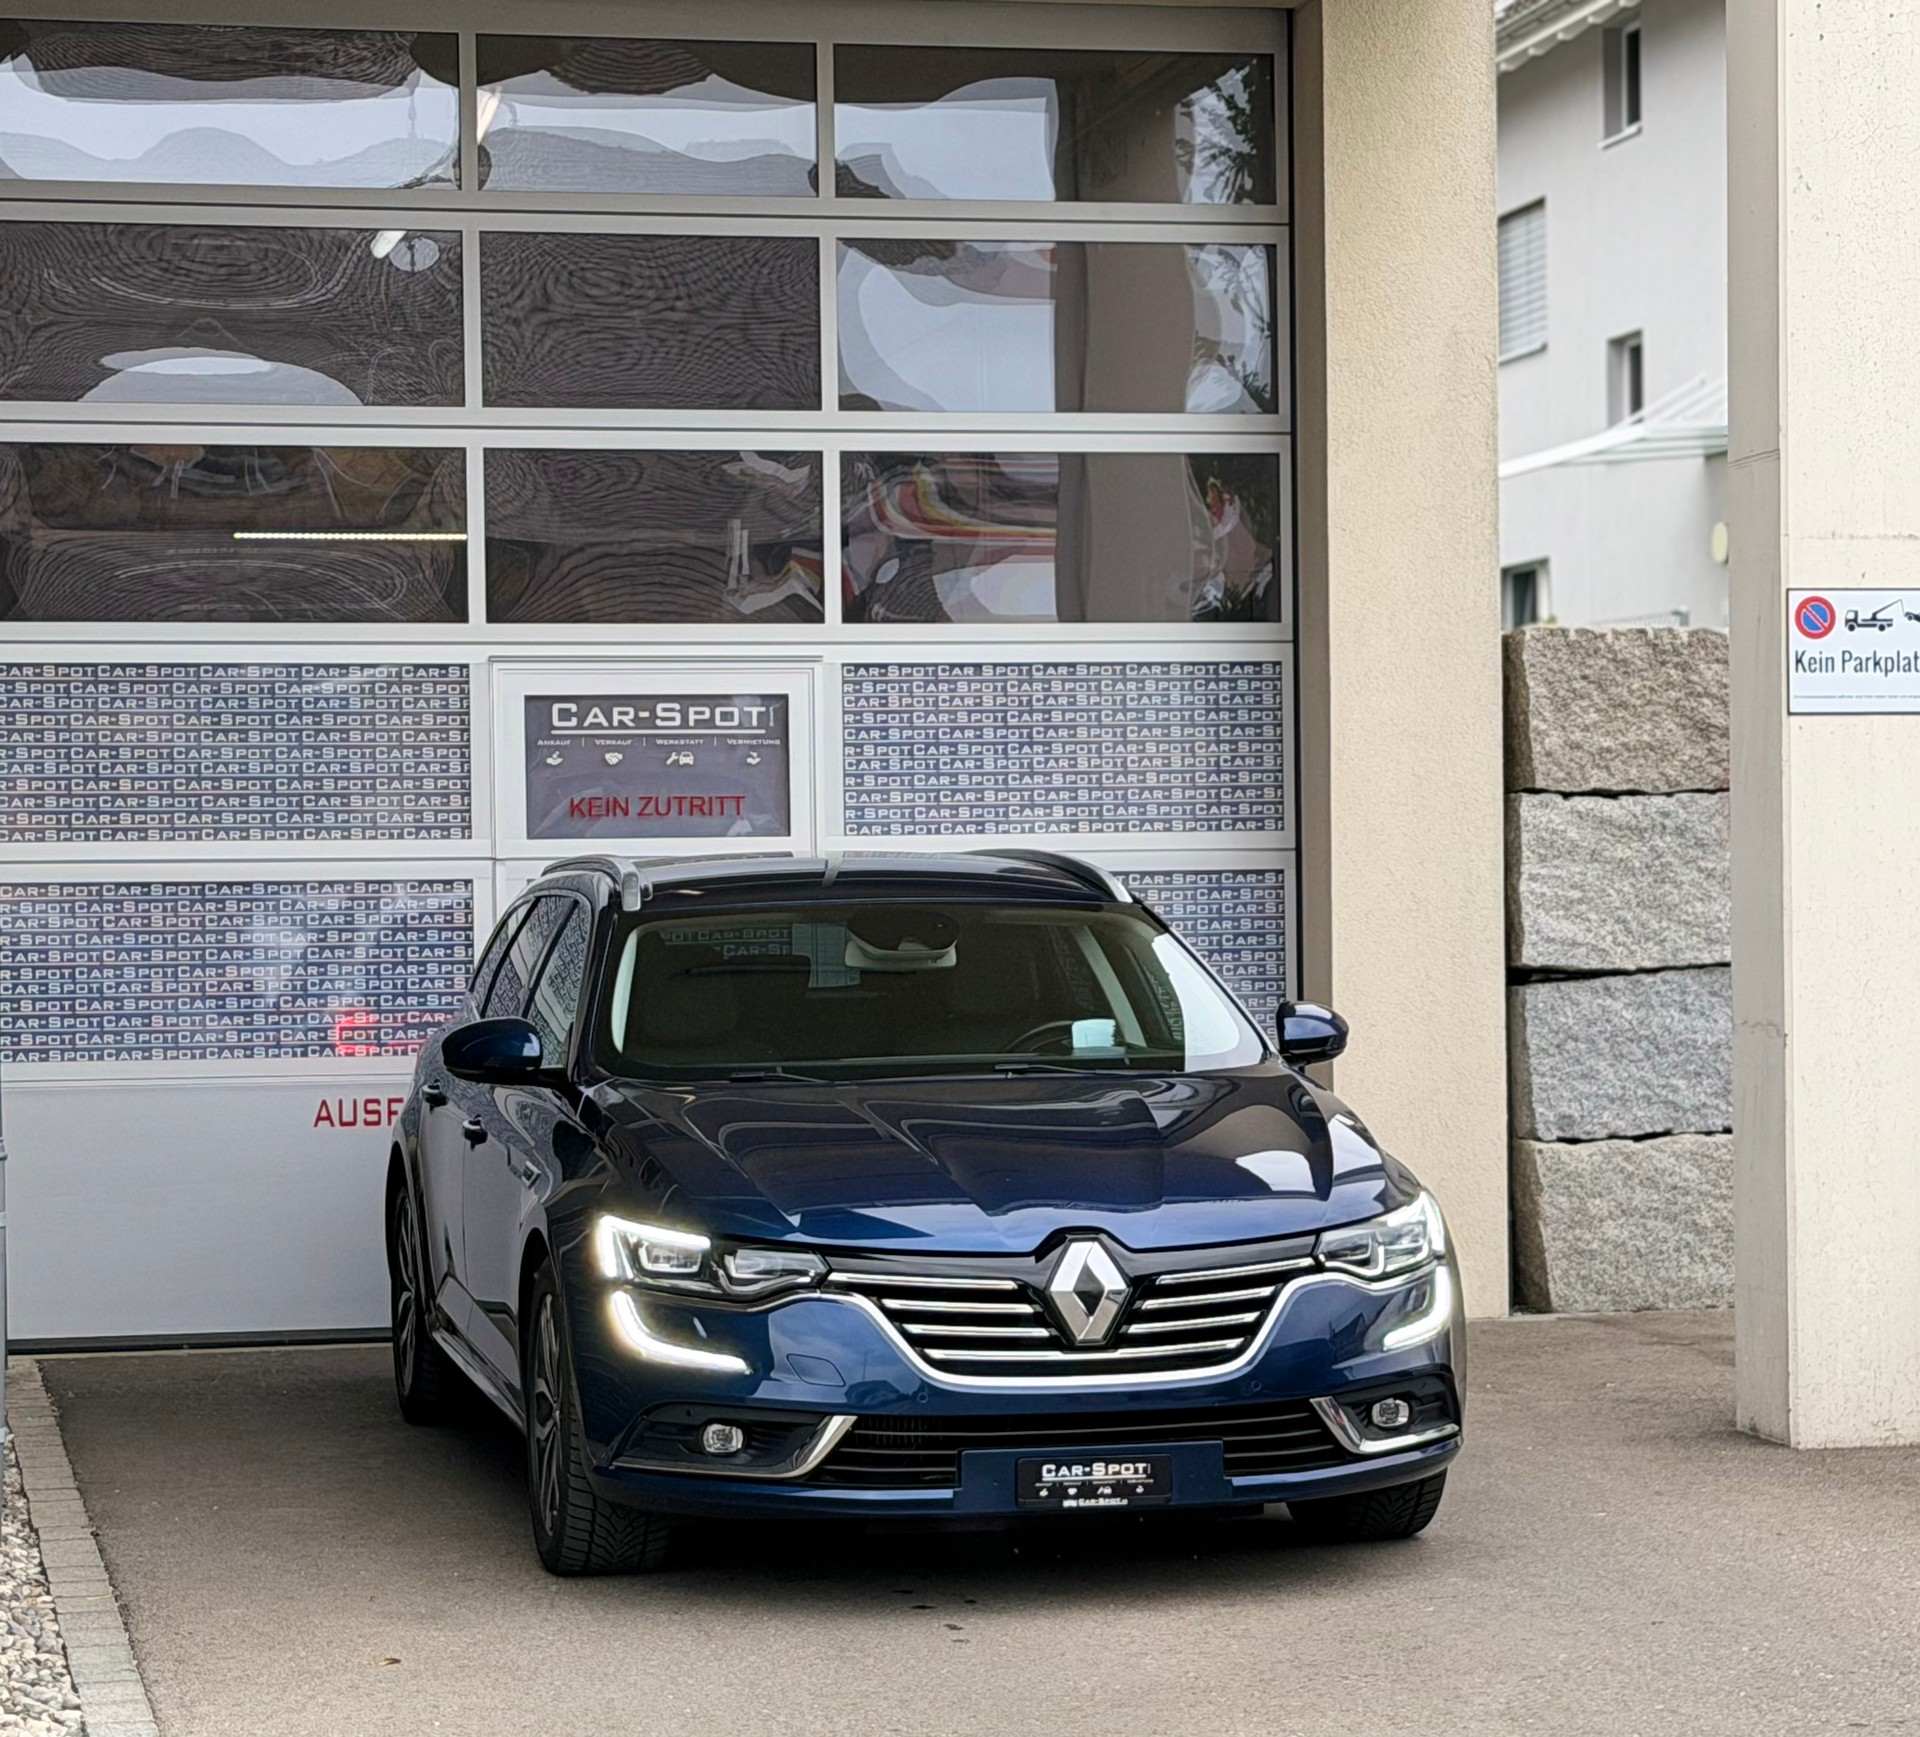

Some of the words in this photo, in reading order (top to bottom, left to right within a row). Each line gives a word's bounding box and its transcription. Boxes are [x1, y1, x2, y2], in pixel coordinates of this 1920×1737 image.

[1795, 649, 1835, 673] Kein
[1841, 649, 1920, 677] Parkplat
[551, 702, 766, 728] CAR-SPOT
[570, 796, 630, 818] KEIN
[637, 795, 746, 817] ZUTRITT
[1042, 1462, 1147, 1477] CAR-SPOT
